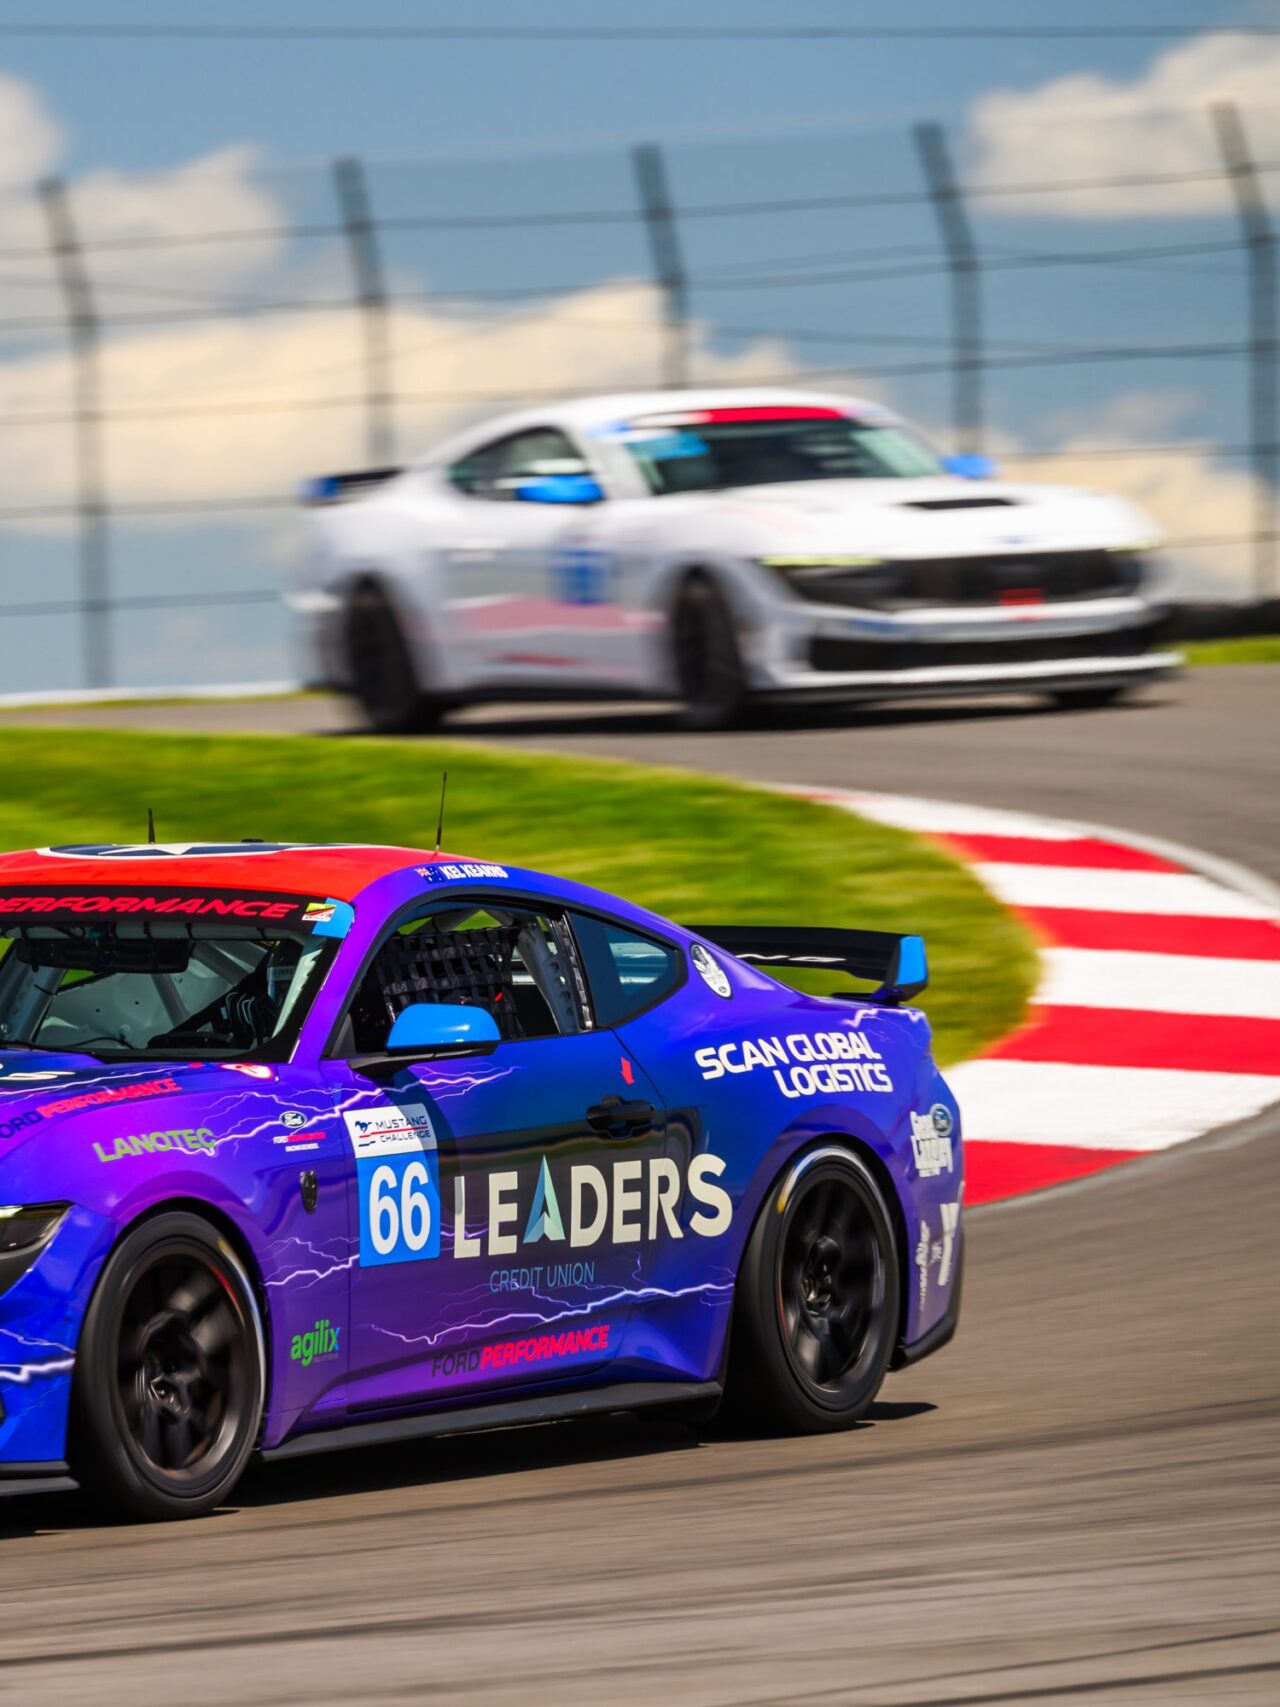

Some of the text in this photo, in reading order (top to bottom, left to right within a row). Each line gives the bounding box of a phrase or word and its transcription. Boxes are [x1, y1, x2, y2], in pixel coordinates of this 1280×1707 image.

[694, 1032, 882, 1080] SCAN GLOBAL
[773, 1063, 893, 1098] LOGISTICS
[375, 1115, 428, 1130] MUSTANG
[380, 1129, 431, 1143] CHALLENGE
[93, 1128, 216, 1162] LANOTEC
[370, 1161, 431, 1255] 66
[453, 1153, 733, 1259] LEADERS
[489, 1261, 595, 1293] CREDIT UNION
[290, 1319, 341, 1367] agilix
